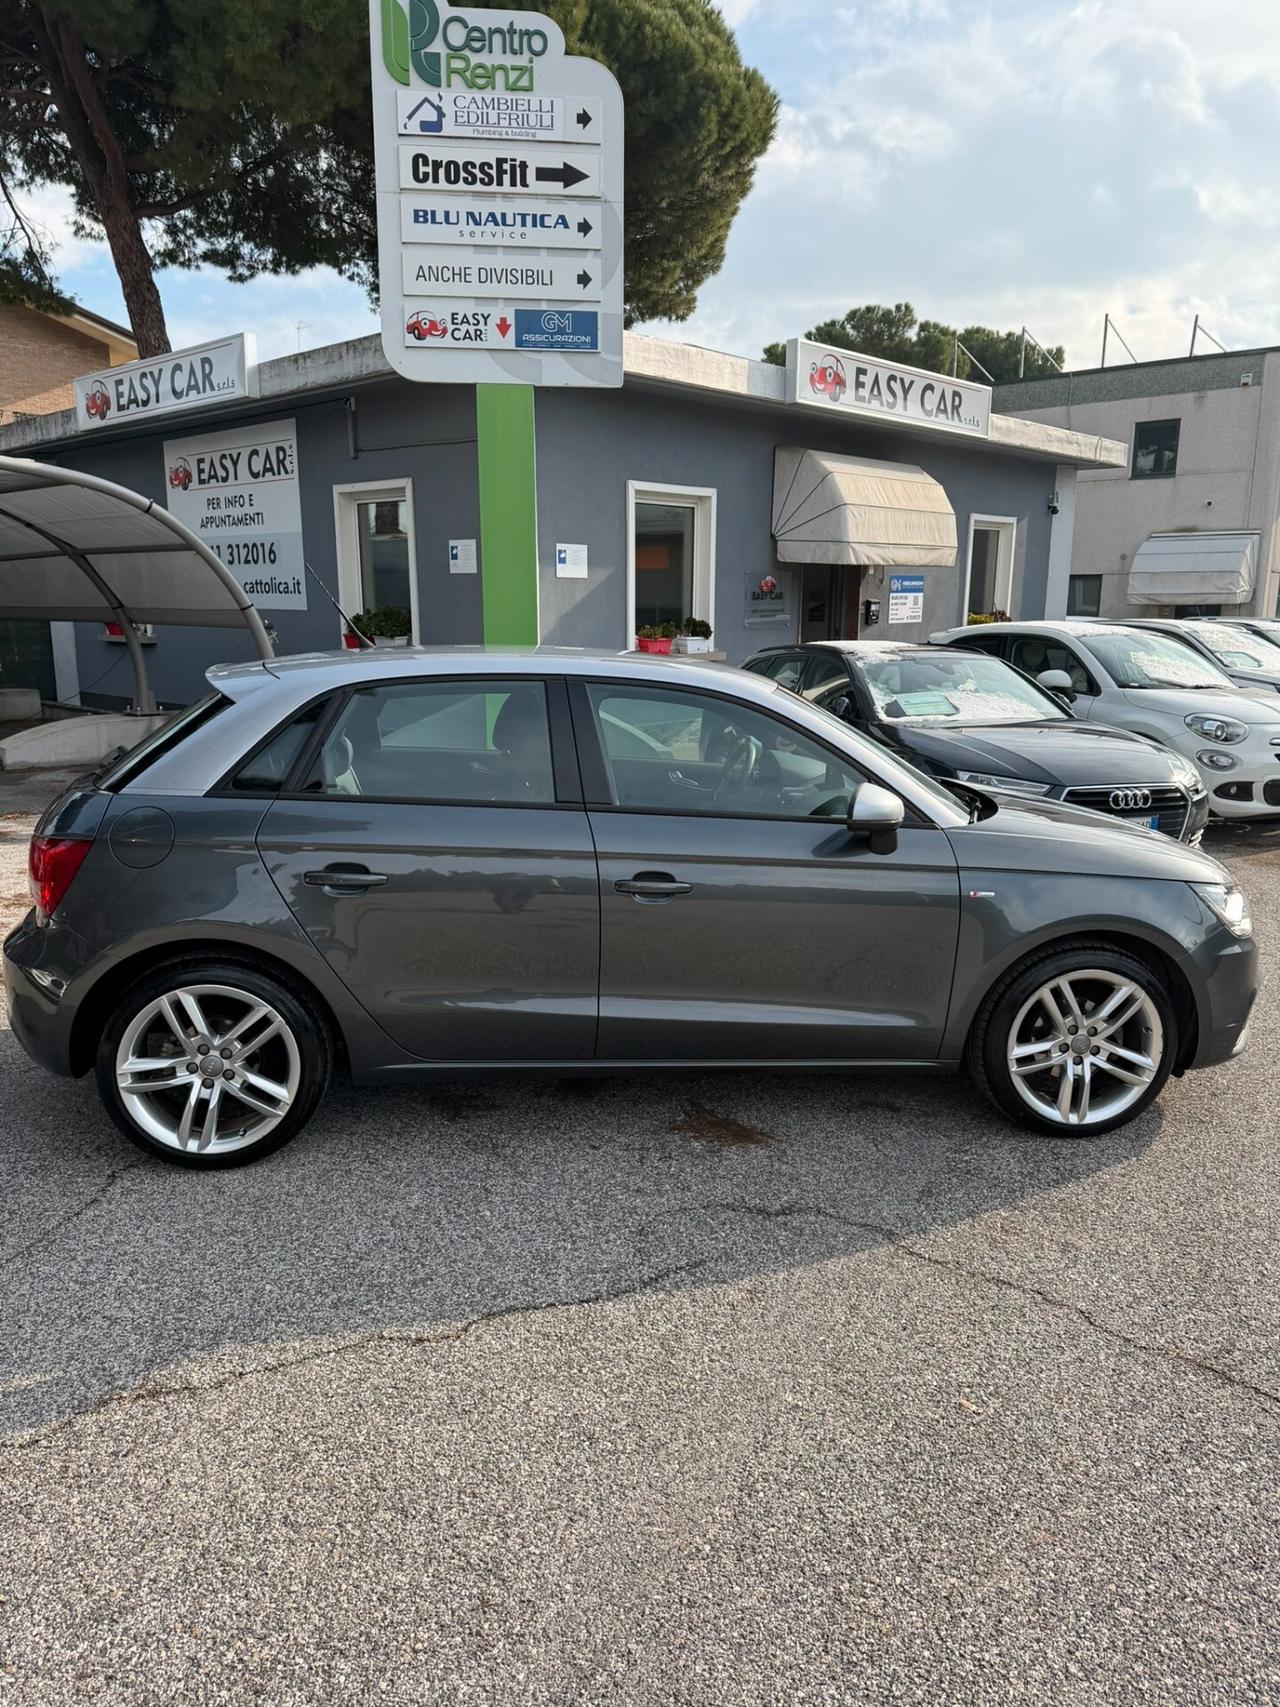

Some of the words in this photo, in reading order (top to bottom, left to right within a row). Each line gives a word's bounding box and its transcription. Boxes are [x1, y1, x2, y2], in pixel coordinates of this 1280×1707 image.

[442, 15, 548, 56] Centro
[446, 52, 534, 92] Renzi
[453, 95, 554, 114] CAMBIELLI
[454, 110, 554, 129] EDILFRIULI
[472, 128, 503, 137] Plumbing
[411, 153, 530, 188] CrossFit
[413, 209, 460, 226] BLU
[465, 211, 570, 230] NAUTICA
[458, 229, 528, 240] service
[415, 264, 473, 284] ANCHE
[478, 267, 554, 286] DIVISIBILI
[451, 312, 492, 327] EASY
[541, 311, 572, 332] GM
[450, 327, 484, 342] CAR
[522, 333, 592, 343] ASSICURAZIONI
[114, 368, 163, 412] EASY
[170, 356, 216, 400] CAR
[854, 366, 915, 412] EASY
[920, 382, 963, 423] CAR
[196, 451, 242, 485] EASY
[247, 446, 290, 480] CAR
[206, 497, 222, 511] PER
[224, 494, 246, 509] INFO
[248, 493, 254, 507] E
[200, 512, 264, 529] APPUNTAMENTI
[227, 542, 277, 566] 312016
[752, 591, 770, 601] EASY
